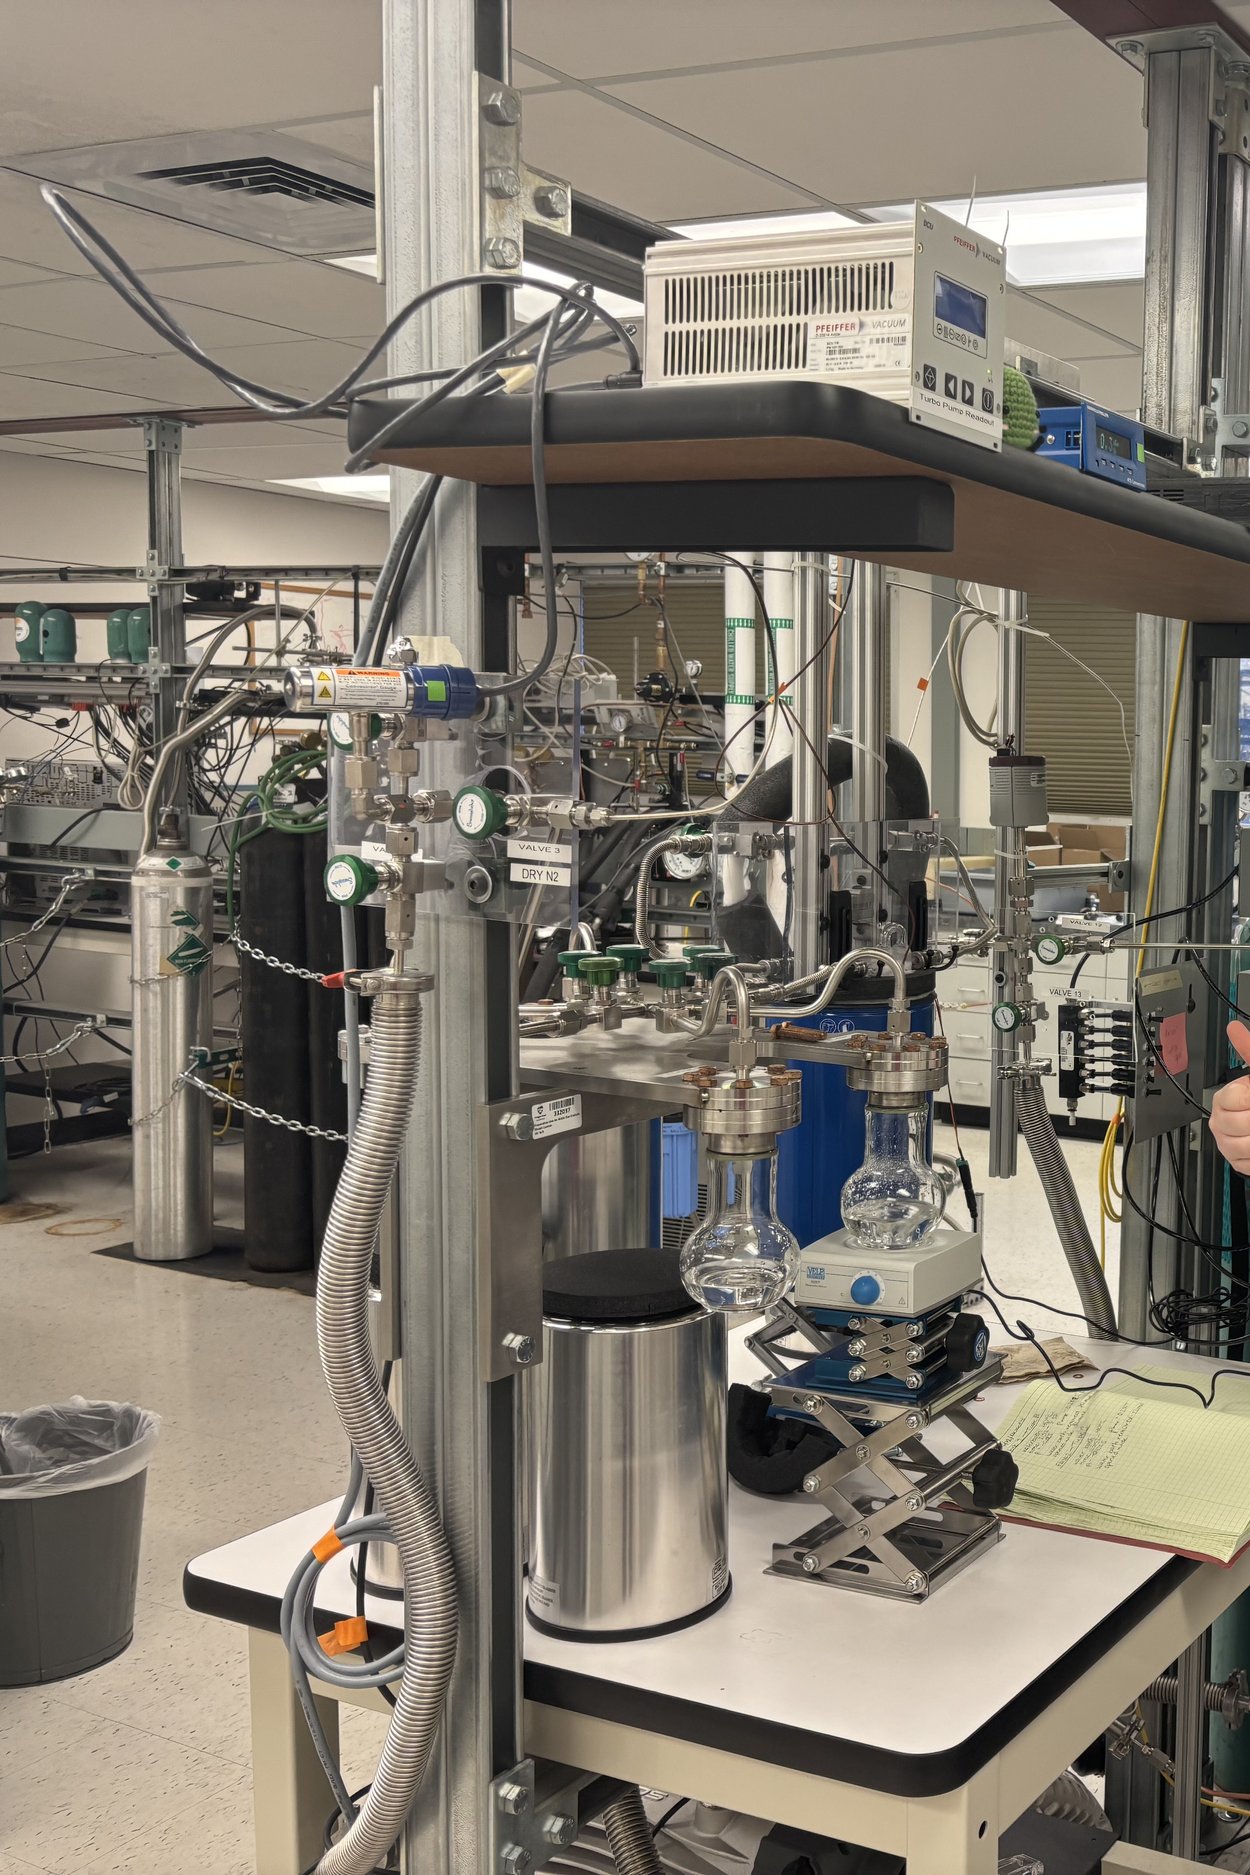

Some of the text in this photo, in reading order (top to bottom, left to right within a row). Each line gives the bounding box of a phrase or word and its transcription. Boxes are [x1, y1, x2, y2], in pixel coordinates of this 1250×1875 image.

[953, 235, 1001, 266] PFEIFFER VACUUM
[815, 319, 906, 333] PFEIFFER VACUUM
[919, 392, 995, 426] Turbo Pump Readout
[727, 654, 735, 672] WATER
[727, 673, 735, 694] SUPPLY
[518, 843, 551, 853] VALVE
[522, 868, 559, 883] DRY N2
[1070, 920, 1091, 928] VALVE
[1049, 989, 1083, 998] VALVE 13
